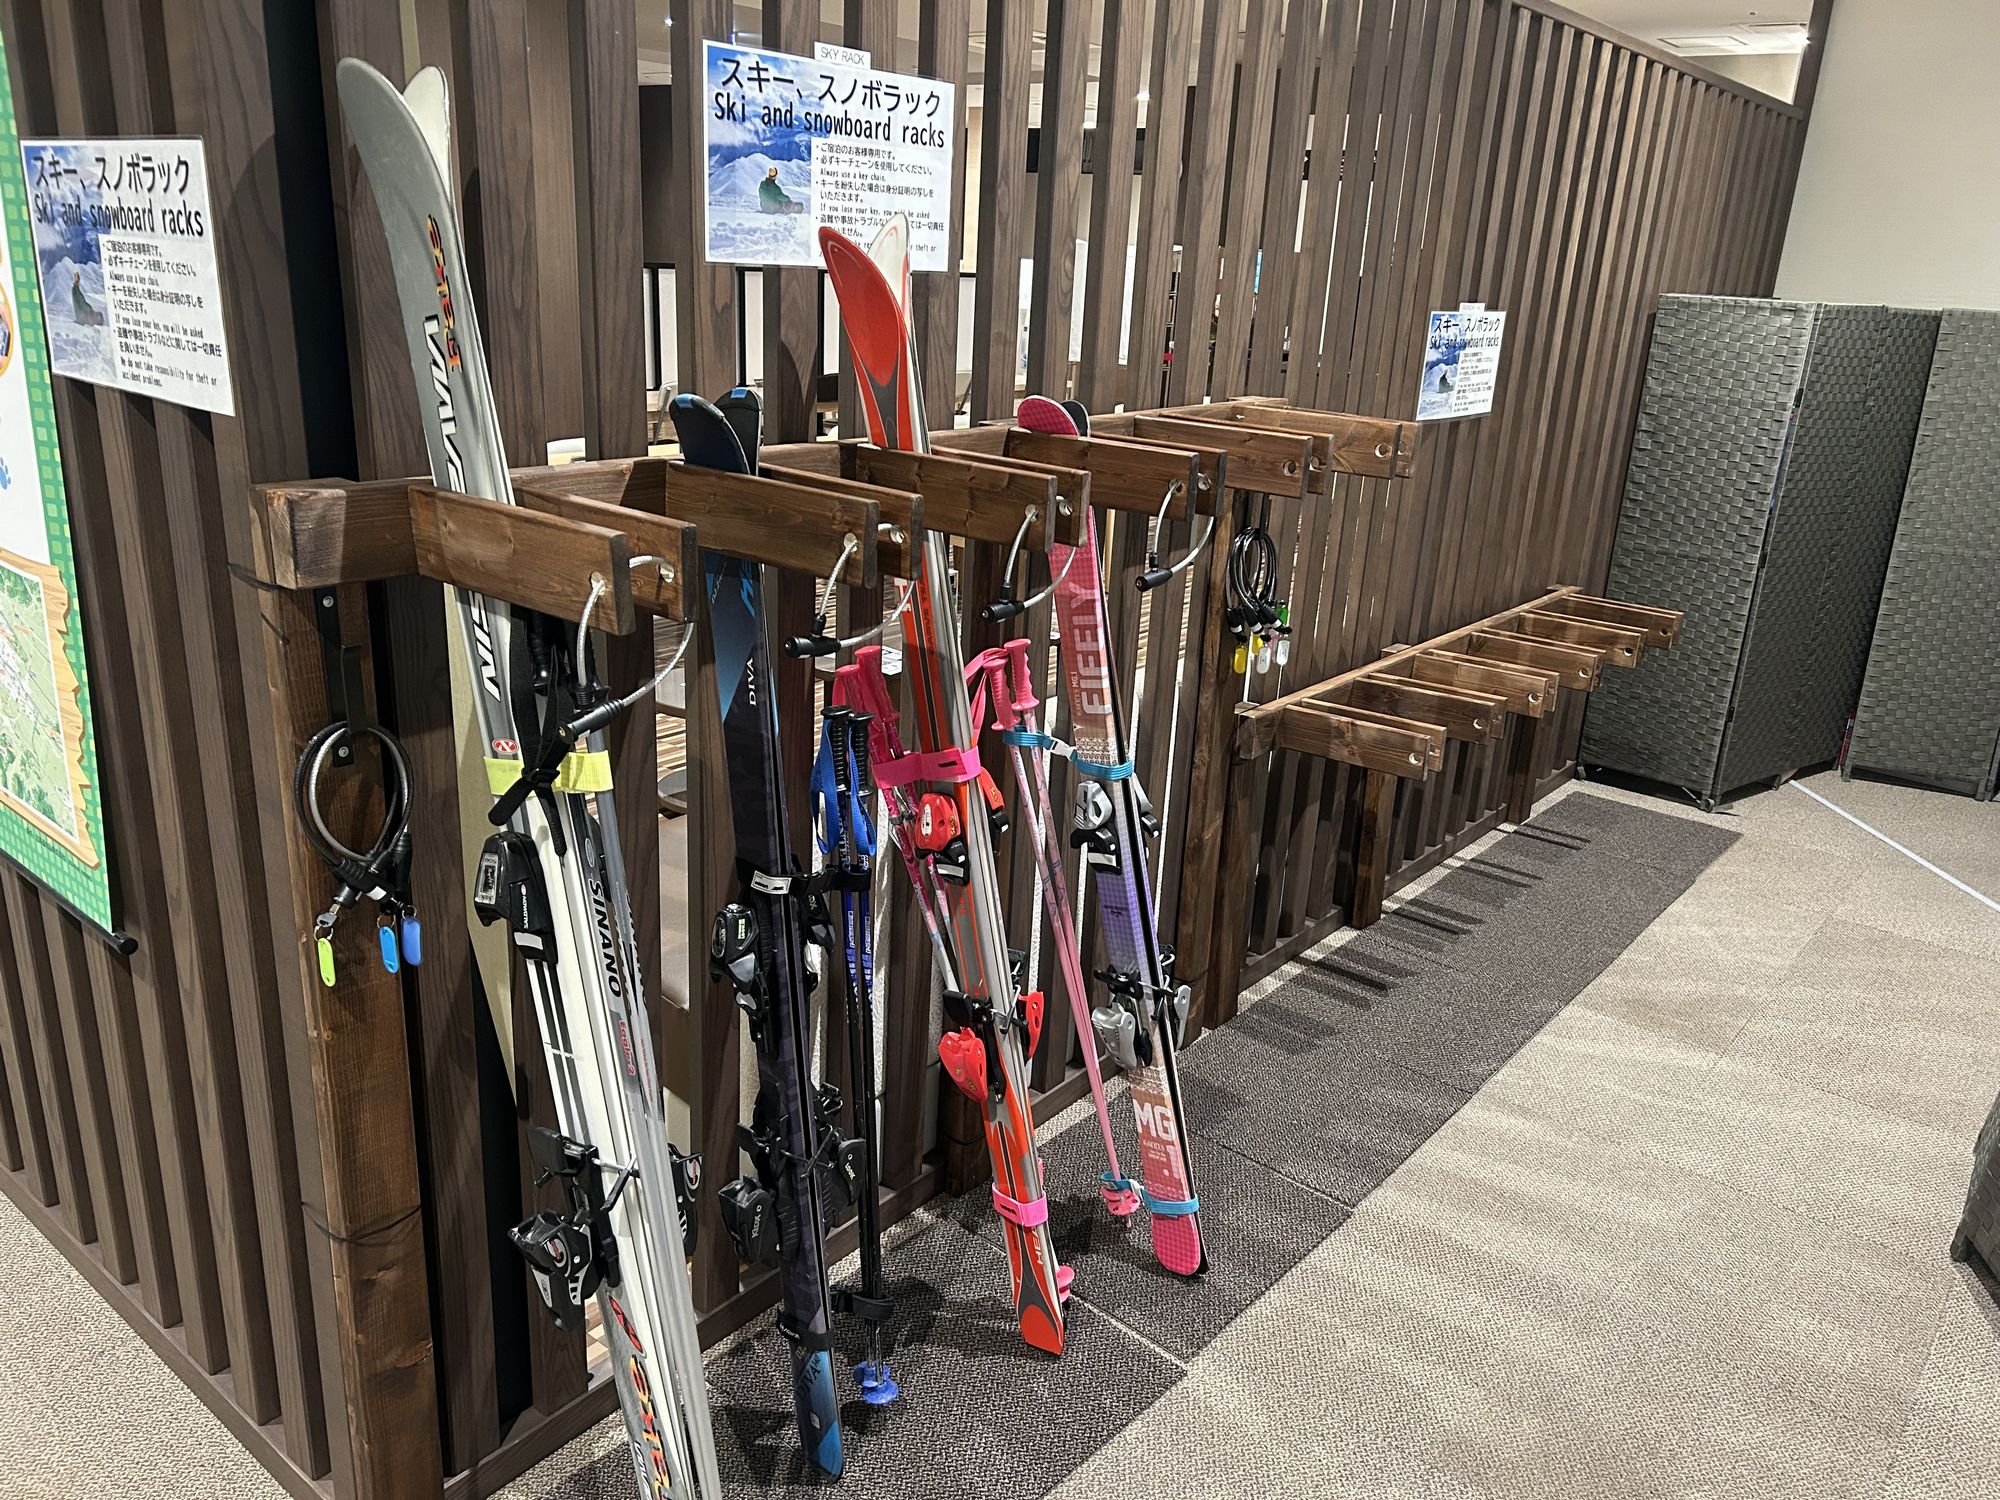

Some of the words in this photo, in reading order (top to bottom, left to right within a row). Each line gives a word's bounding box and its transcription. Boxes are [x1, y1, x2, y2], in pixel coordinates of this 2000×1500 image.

[820, 47, 840, 61] SKY
[841, 50, 865, 65] RACK
[721, 57, 940, 118] スキー、スノボラック
[714, 92, 746, 122] Ski
[762, 102, 793, 128] and
[804, 110, 891, 142] snowboard
[903, 122, 944, 148] racks
[33, 154, 190, 194] スキー、スノボラック
[820, 168, 838, 178] Always
[841, 171, 850, 179] use
[859, 172, 868, 181] key
[34, 193, 54, 224] Ski
[62, 201, 82, 227] and
[90, 198, 155, 233] snowboard
[162, 200, 204, 237] racks
[820, 191, 864, 203] いただきます。
[841, 204, 853, 214] lose
[746, 657, 757, 706] DIVA
[588, 878, 623, 998] SINANO
[1133, 1099, 1175, 1140] MG
